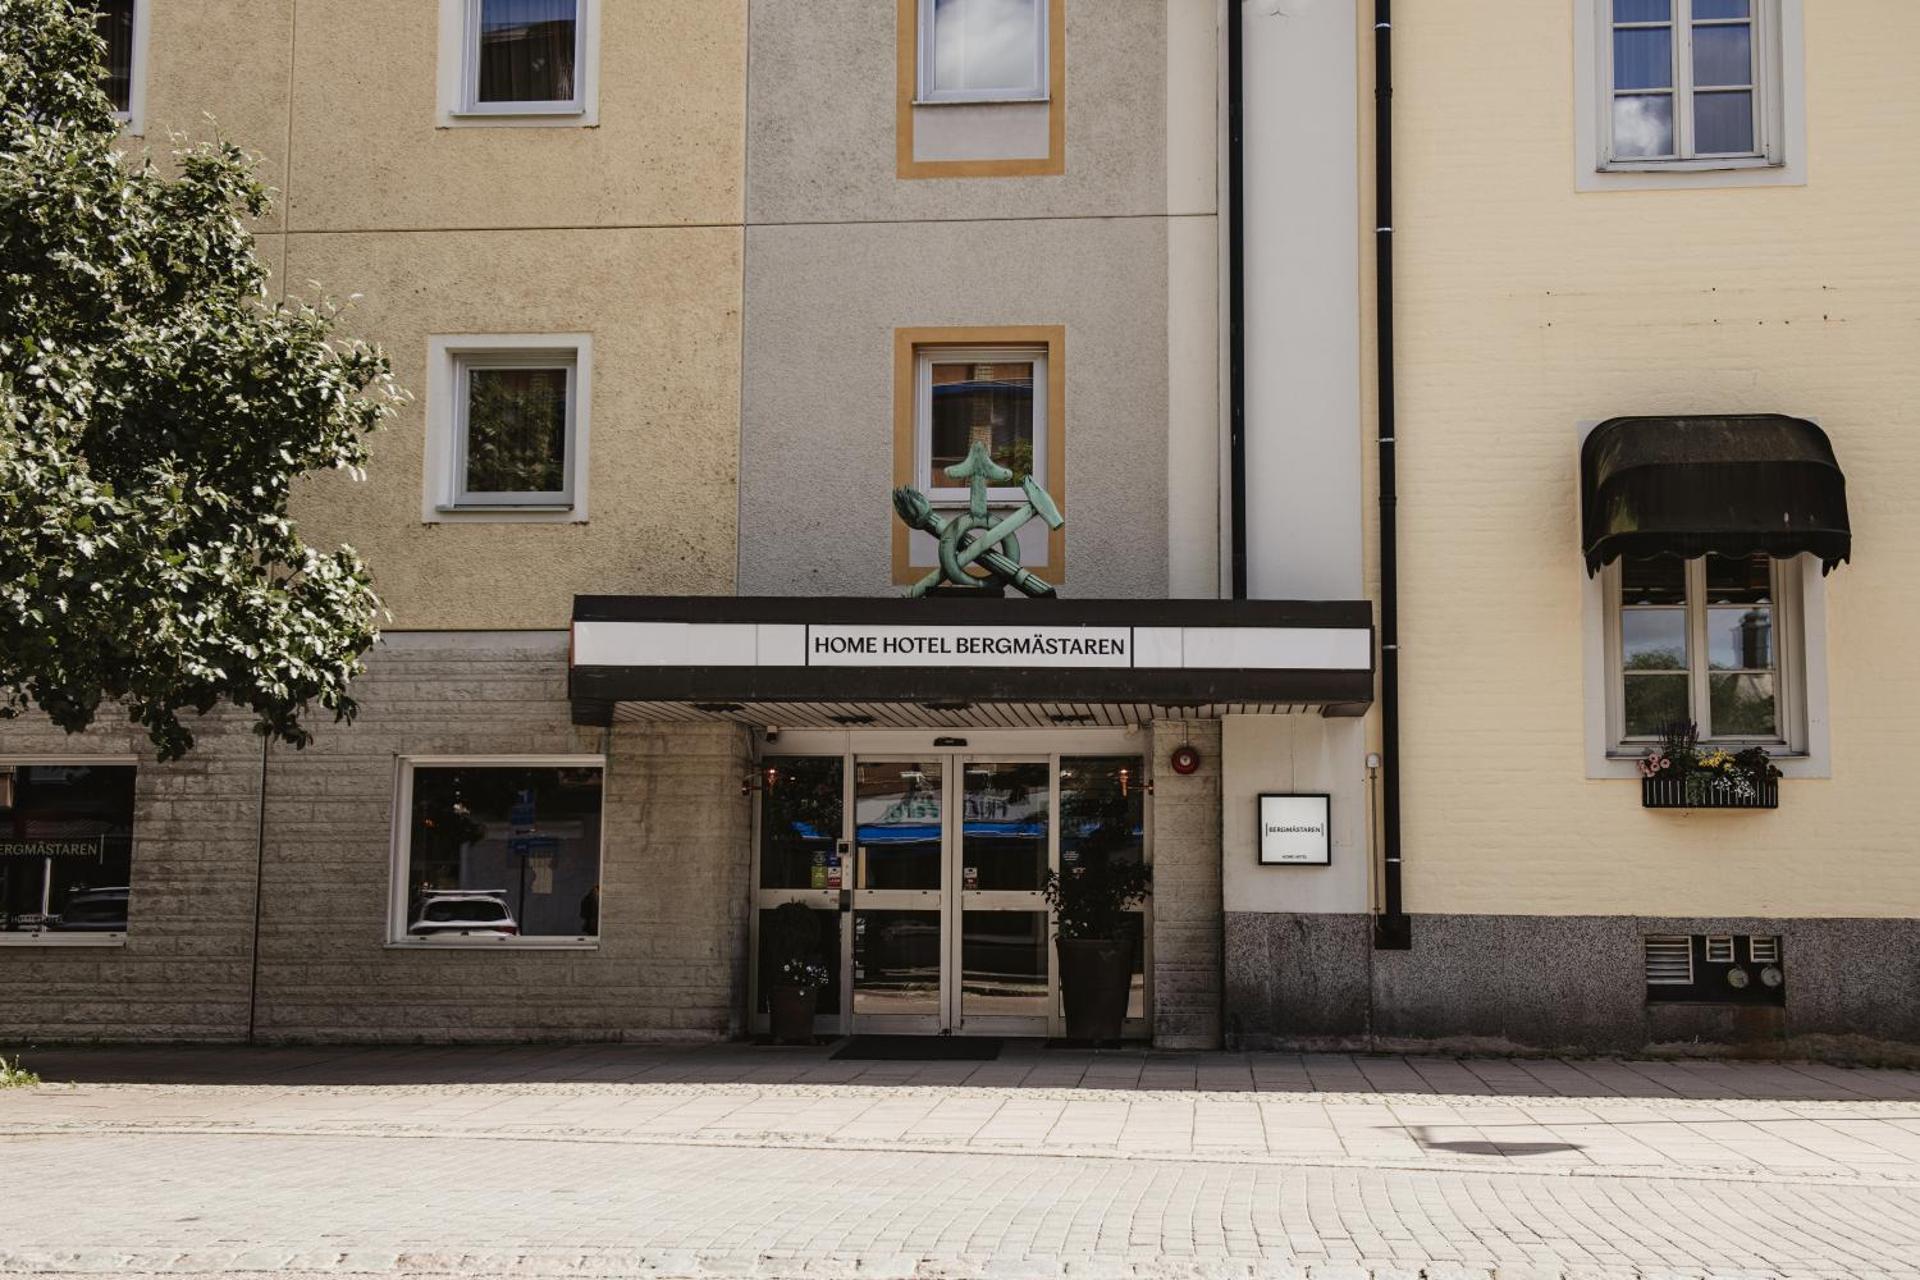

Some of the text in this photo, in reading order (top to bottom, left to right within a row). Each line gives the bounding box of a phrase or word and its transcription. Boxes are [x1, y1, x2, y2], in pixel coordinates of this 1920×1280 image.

[815, 634, 1125, 655] HOME HOTEL BERGMÄSTAREN
[0, 841, 97, 856] ERGMÄSTAREN
